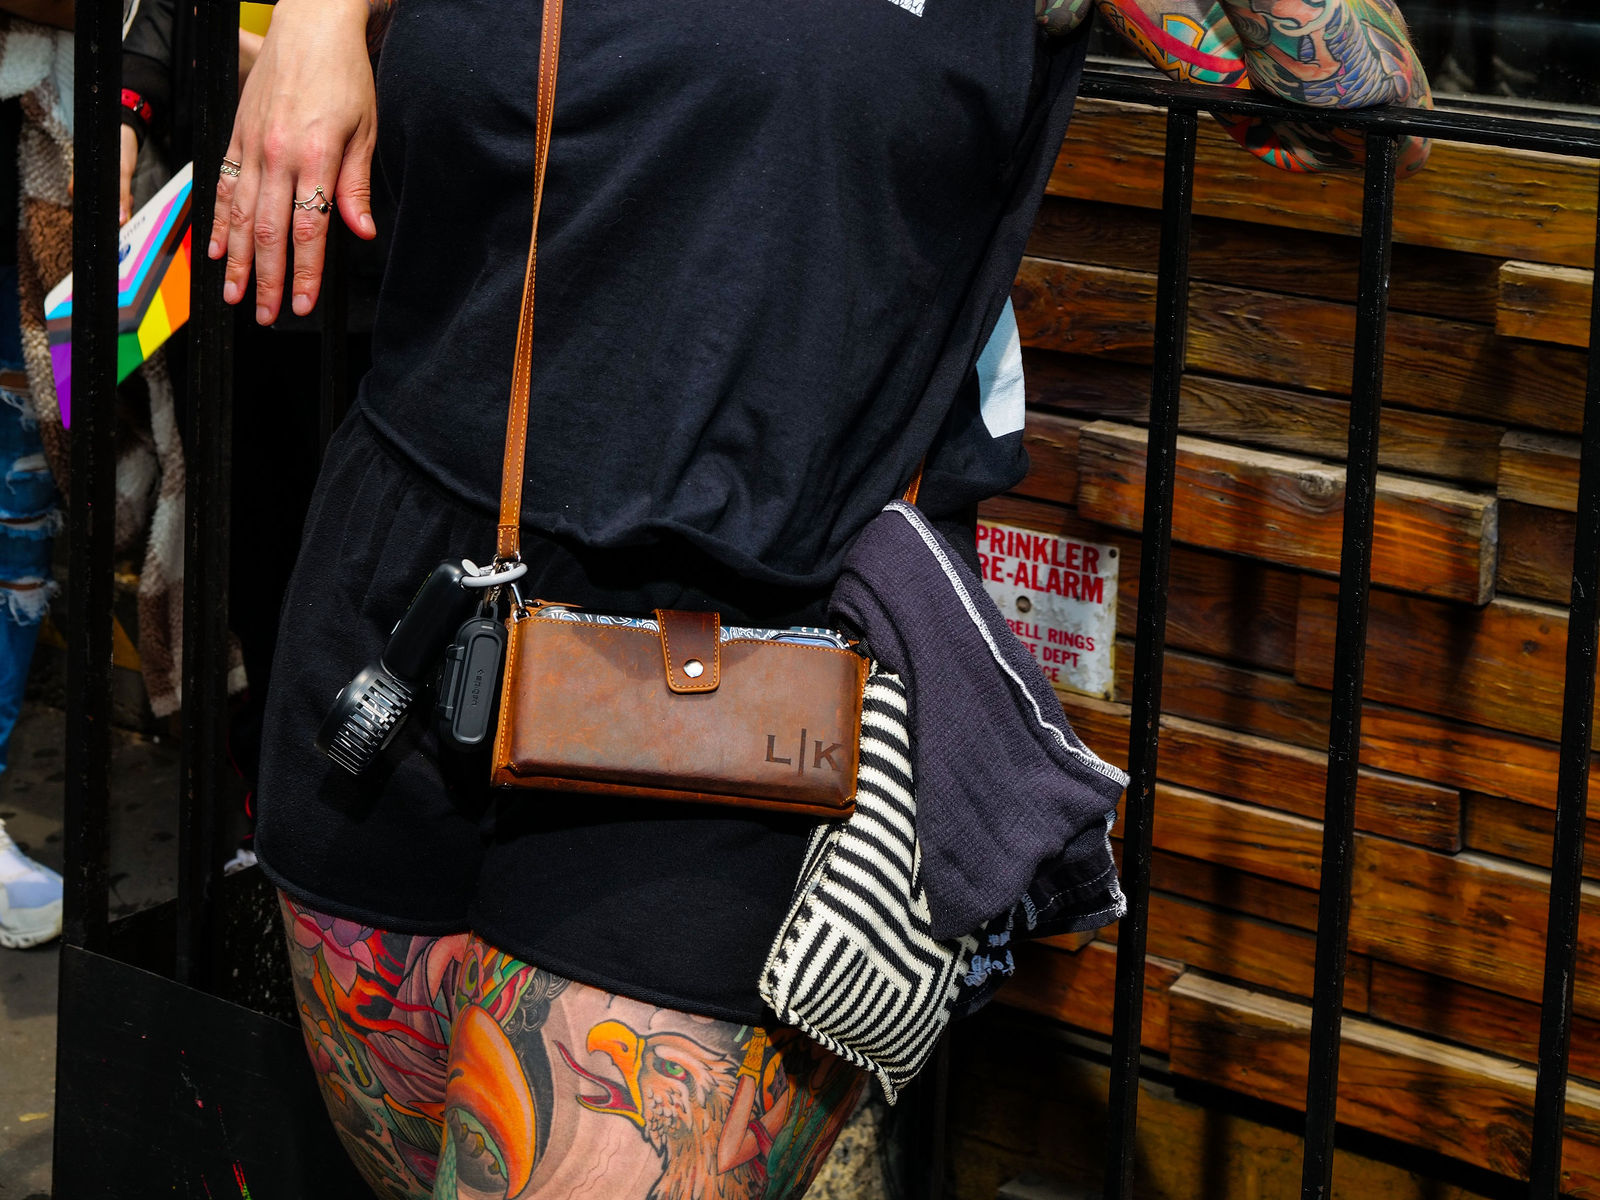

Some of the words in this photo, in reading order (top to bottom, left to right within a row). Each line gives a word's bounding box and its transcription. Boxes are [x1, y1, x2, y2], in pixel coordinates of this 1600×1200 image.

[975, 523, 1100, 575] PRINKLER
[978, 552, 1105, 605] RE-ALARM
[1006, 618, 1043, 641] BELL
[1047, 628, 1096, 652] RINGS
[1043, 646, 1081, 668] DEPT
